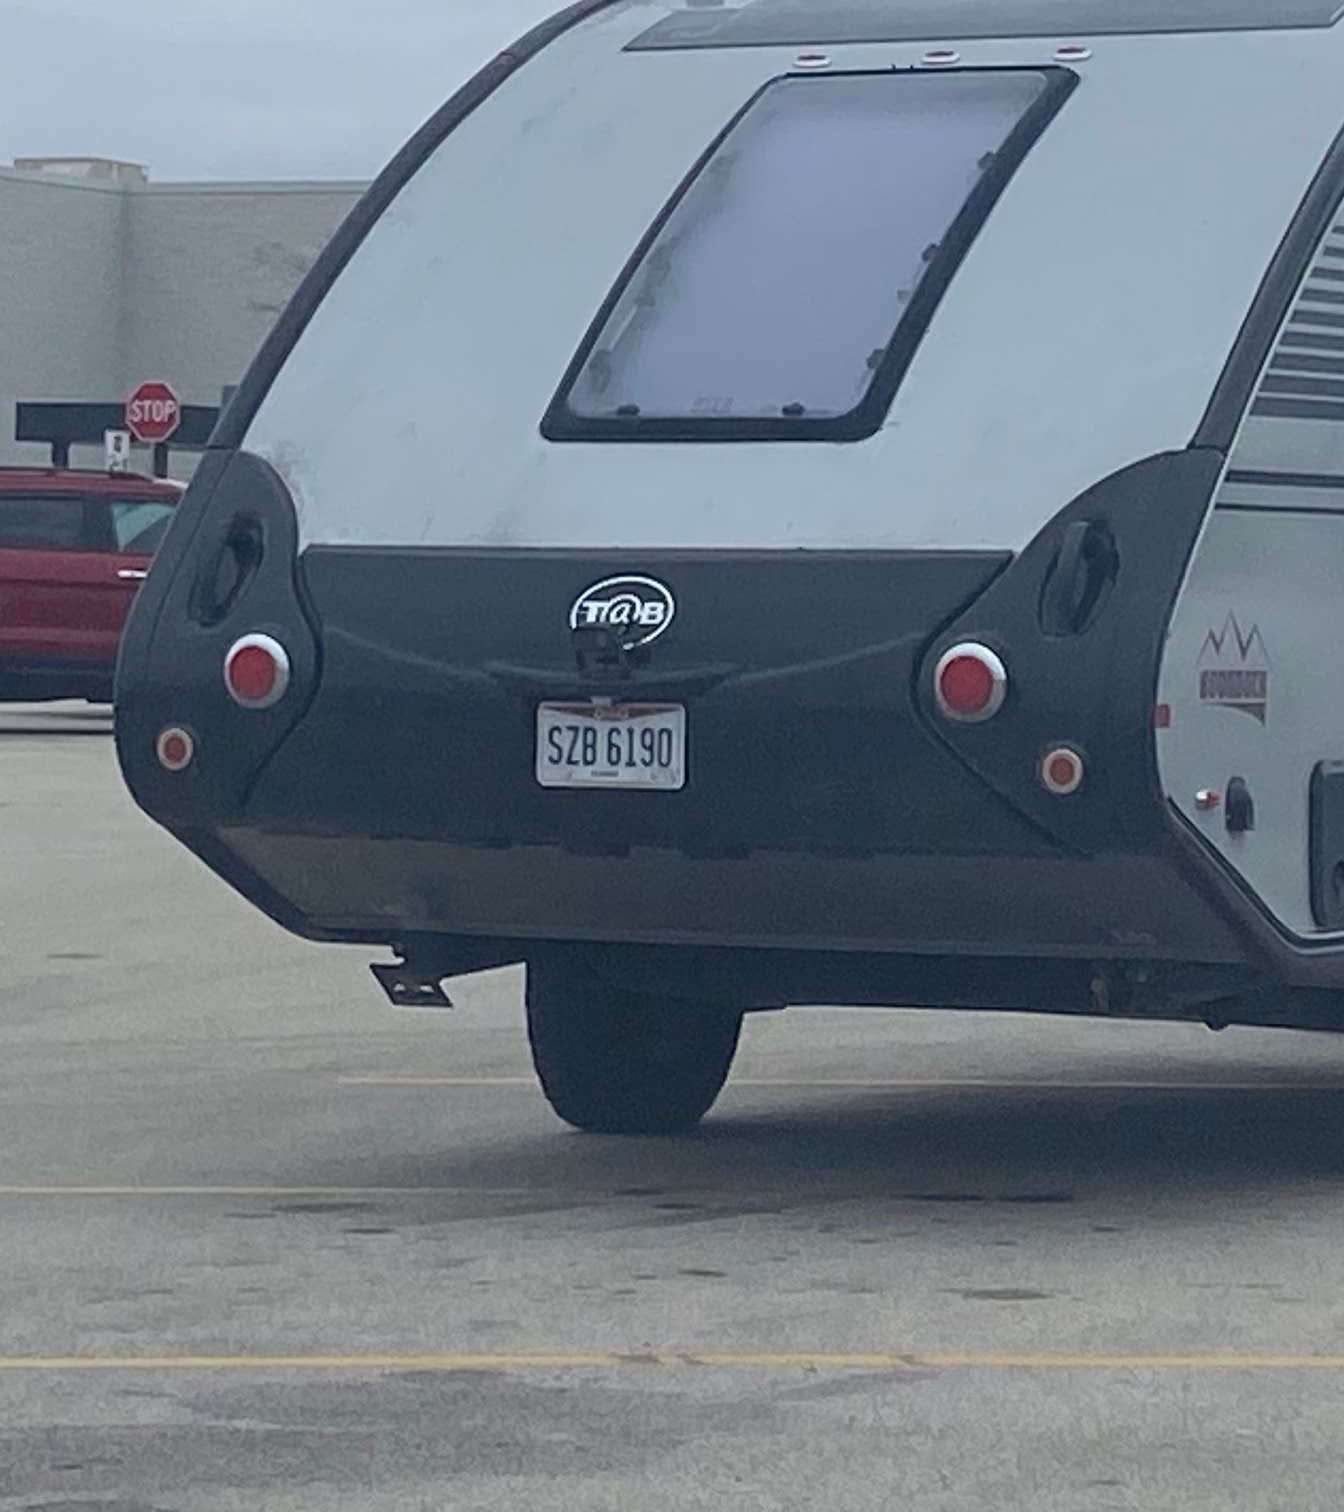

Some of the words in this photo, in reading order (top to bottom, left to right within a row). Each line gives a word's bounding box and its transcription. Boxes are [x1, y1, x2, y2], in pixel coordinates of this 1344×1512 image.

[129, 399, 176, 423] STOP
[548, 726, 598, 766] SZB
[607, 727, 673, 768] 6190
